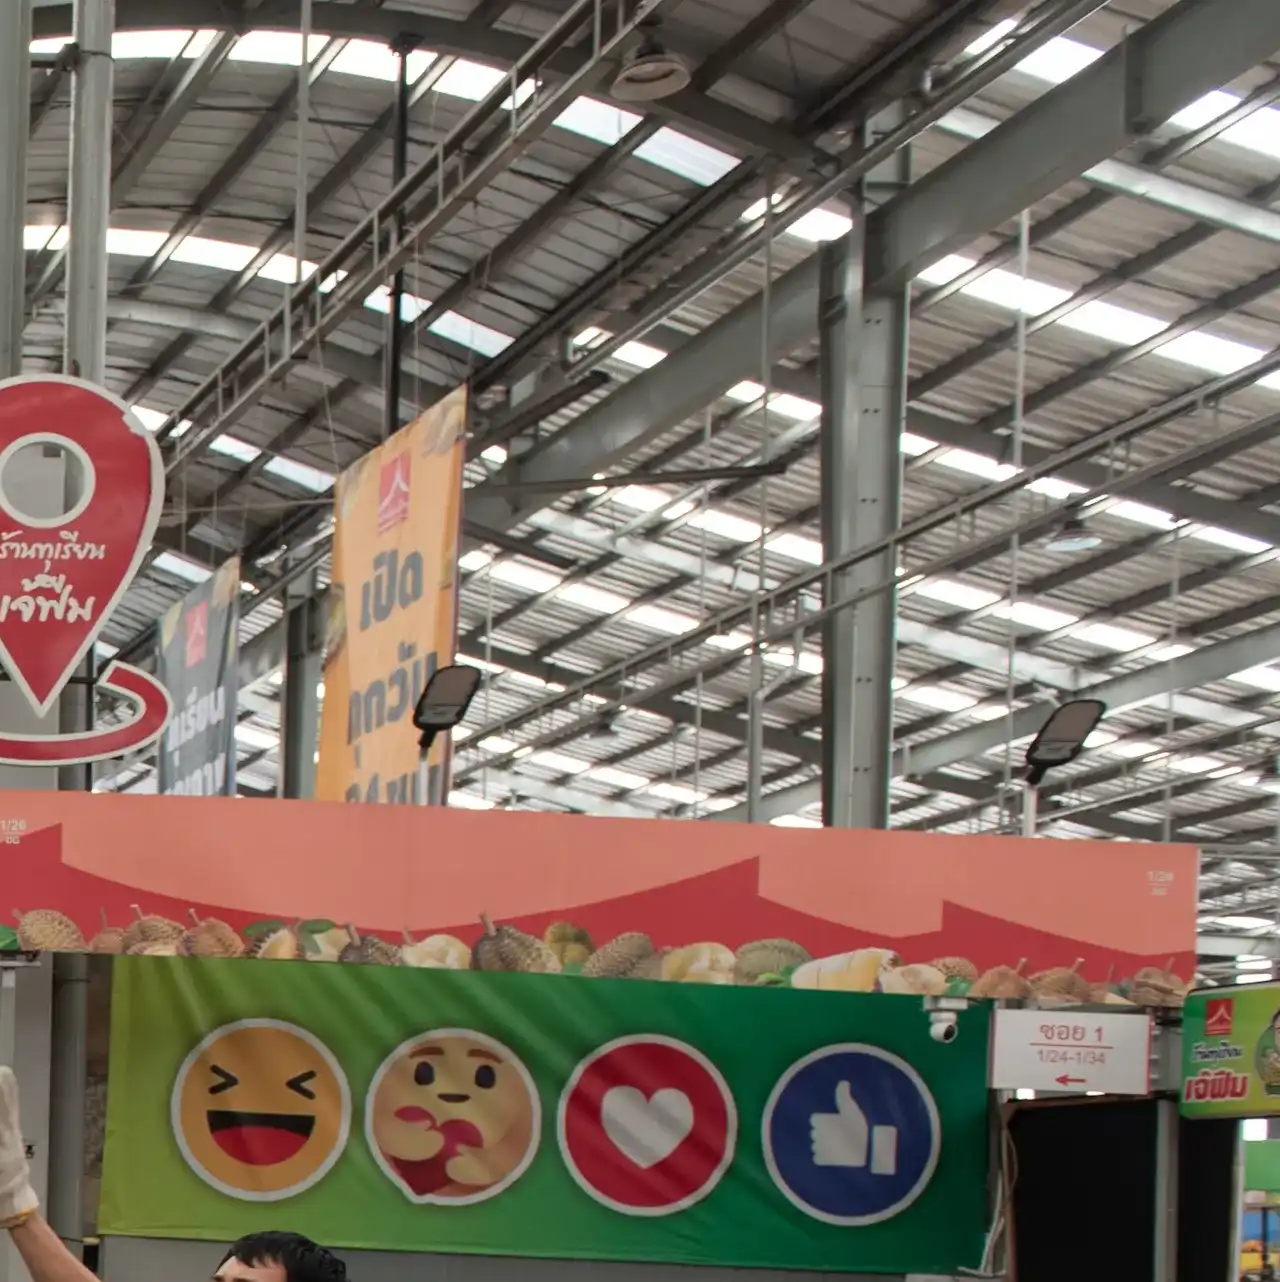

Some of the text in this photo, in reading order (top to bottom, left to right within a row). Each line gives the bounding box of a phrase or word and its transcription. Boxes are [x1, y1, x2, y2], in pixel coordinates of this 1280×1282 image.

[1039, 1024, 1103, 1042] ซอย 1
[1036, 1049, 1106, 1065] 1/24-1/34
